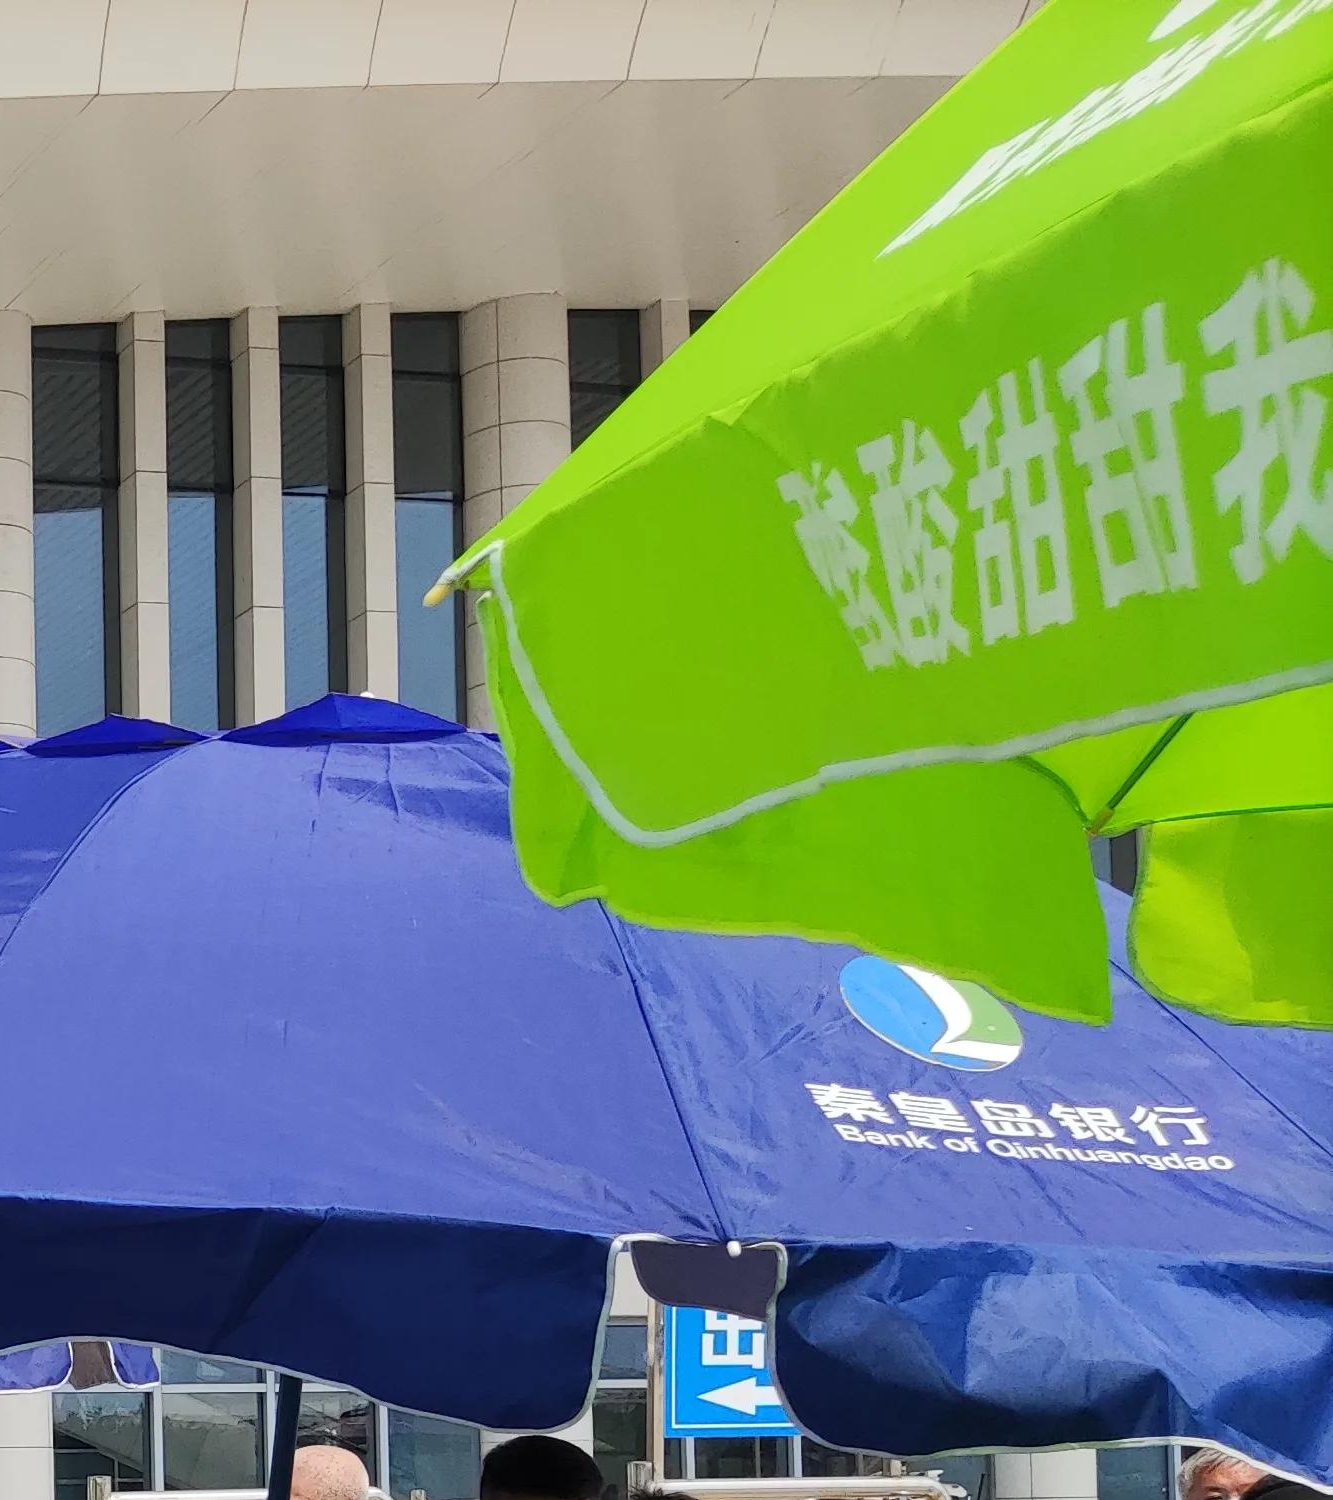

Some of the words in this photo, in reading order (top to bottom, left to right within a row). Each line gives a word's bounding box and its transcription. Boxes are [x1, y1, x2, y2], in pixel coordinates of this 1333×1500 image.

[804, 1082, 1211, 1146] 秦皇岛银行
[835, 1124, 937, 1152] Bank
[943, 1132, 980, 1154] of
[986, 1138, 1235, 1171] Qinhuangdao
